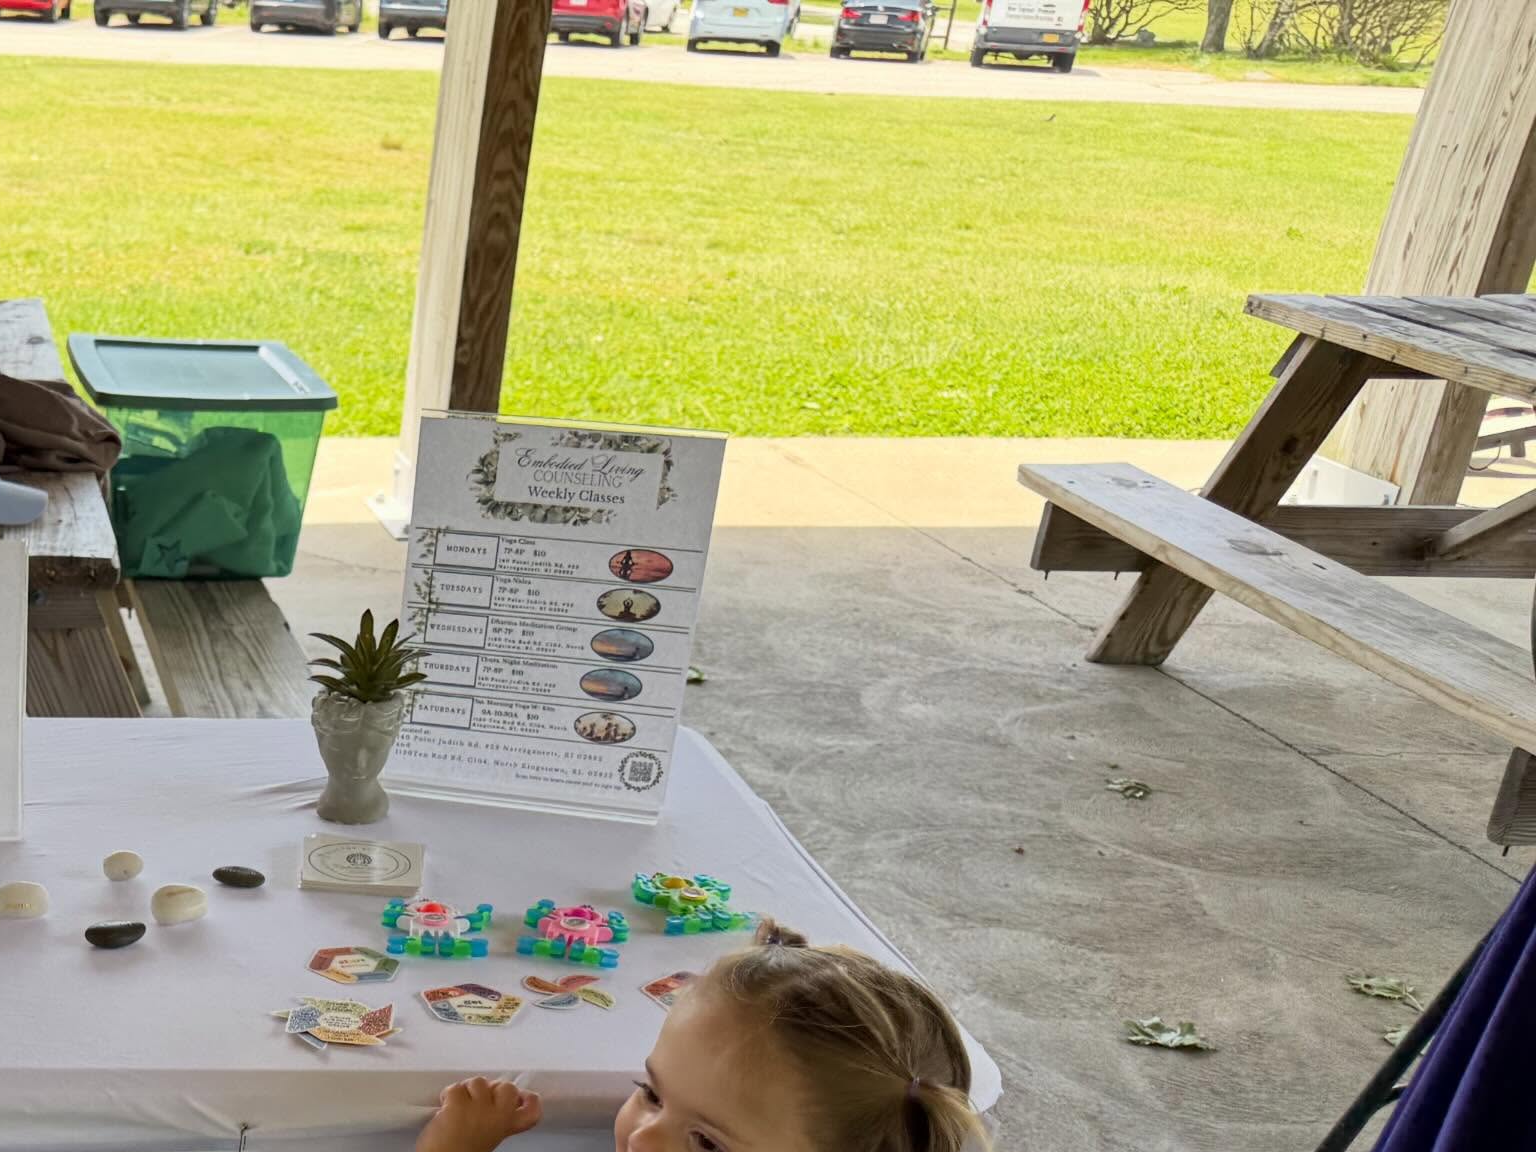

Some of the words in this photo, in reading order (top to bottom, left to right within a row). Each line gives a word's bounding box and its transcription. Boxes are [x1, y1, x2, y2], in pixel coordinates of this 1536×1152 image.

[515, 447, 590, 470] Embodied
[591, 454, 646, 482] Living
[533, 470, 623, 488] COUNSELING
[528, 485, 576, 503] Weekly
[579, 488, 625, 504] Classes
[446, 545, 487, 555] MONDAYS
[440, 583, 483, 594] TUESDAYS
[430, 623, 484, 635] WEDNESDAYS
[424, 662, 471, 673] THURSDAYS
[418, 704, 466, 715] SATURDAYS
[438, 738, 465, 747] Judith
